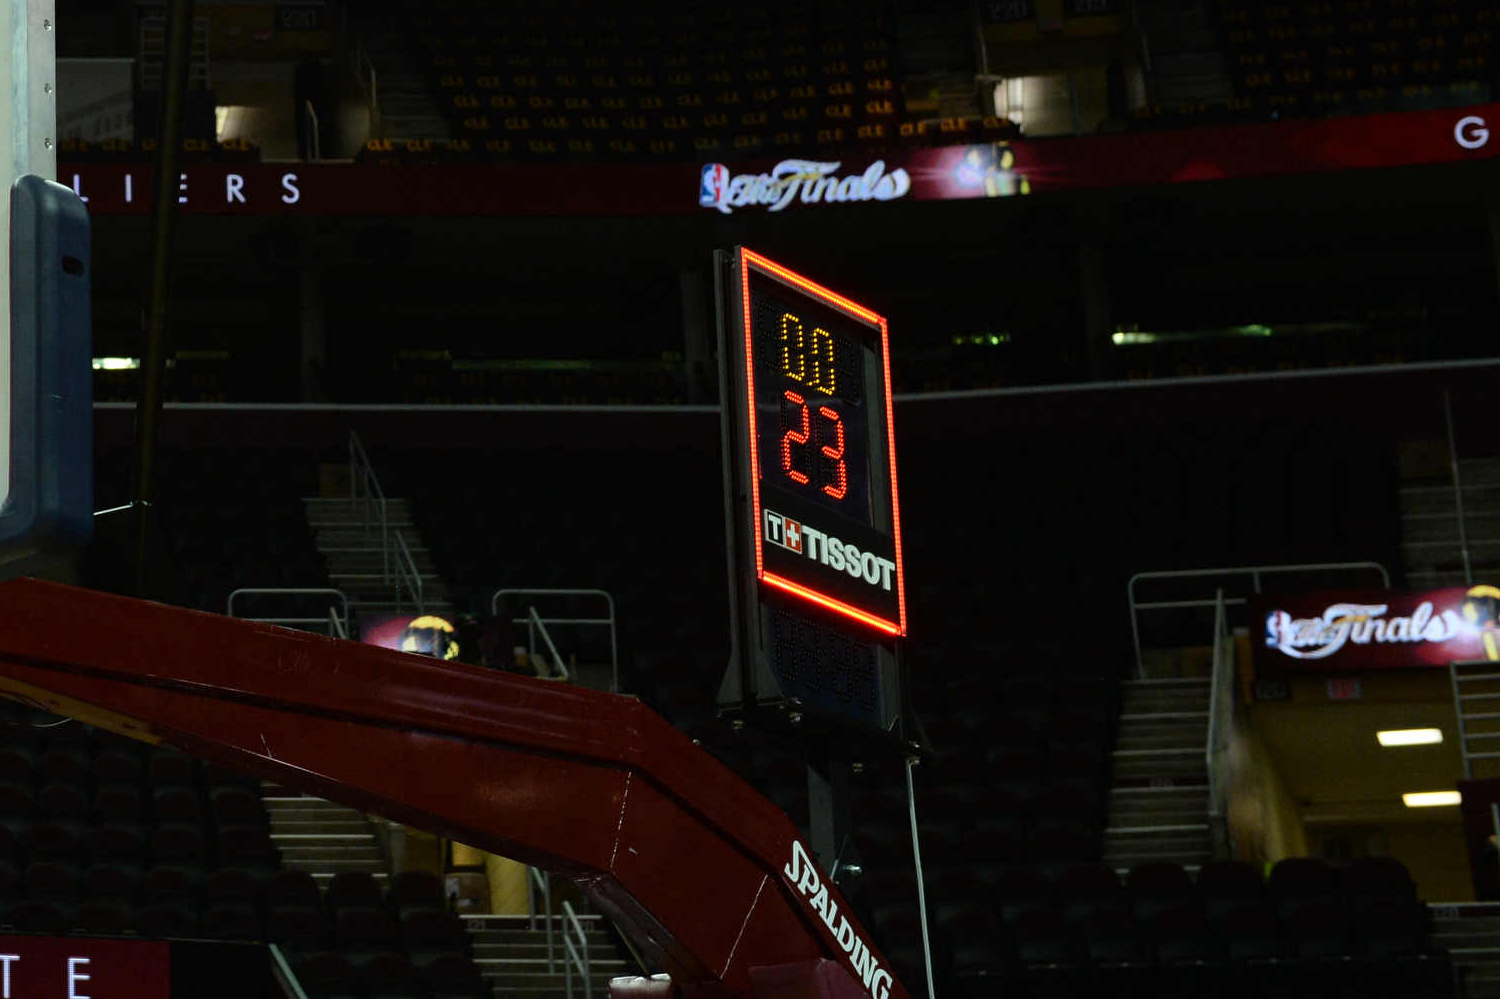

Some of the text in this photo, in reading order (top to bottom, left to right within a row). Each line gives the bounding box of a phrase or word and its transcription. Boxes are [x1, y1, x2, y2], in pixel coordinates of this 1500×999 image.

[1454, 115, 1490, 149] G
[767, 158, 911, 212] Finals
[781, 389, 847, 499] 23
[801, 524, 896, 591] TISSOT
[1295, 601, 1460, 660] Finals
[784, 840, 894, 999] SPALDING
